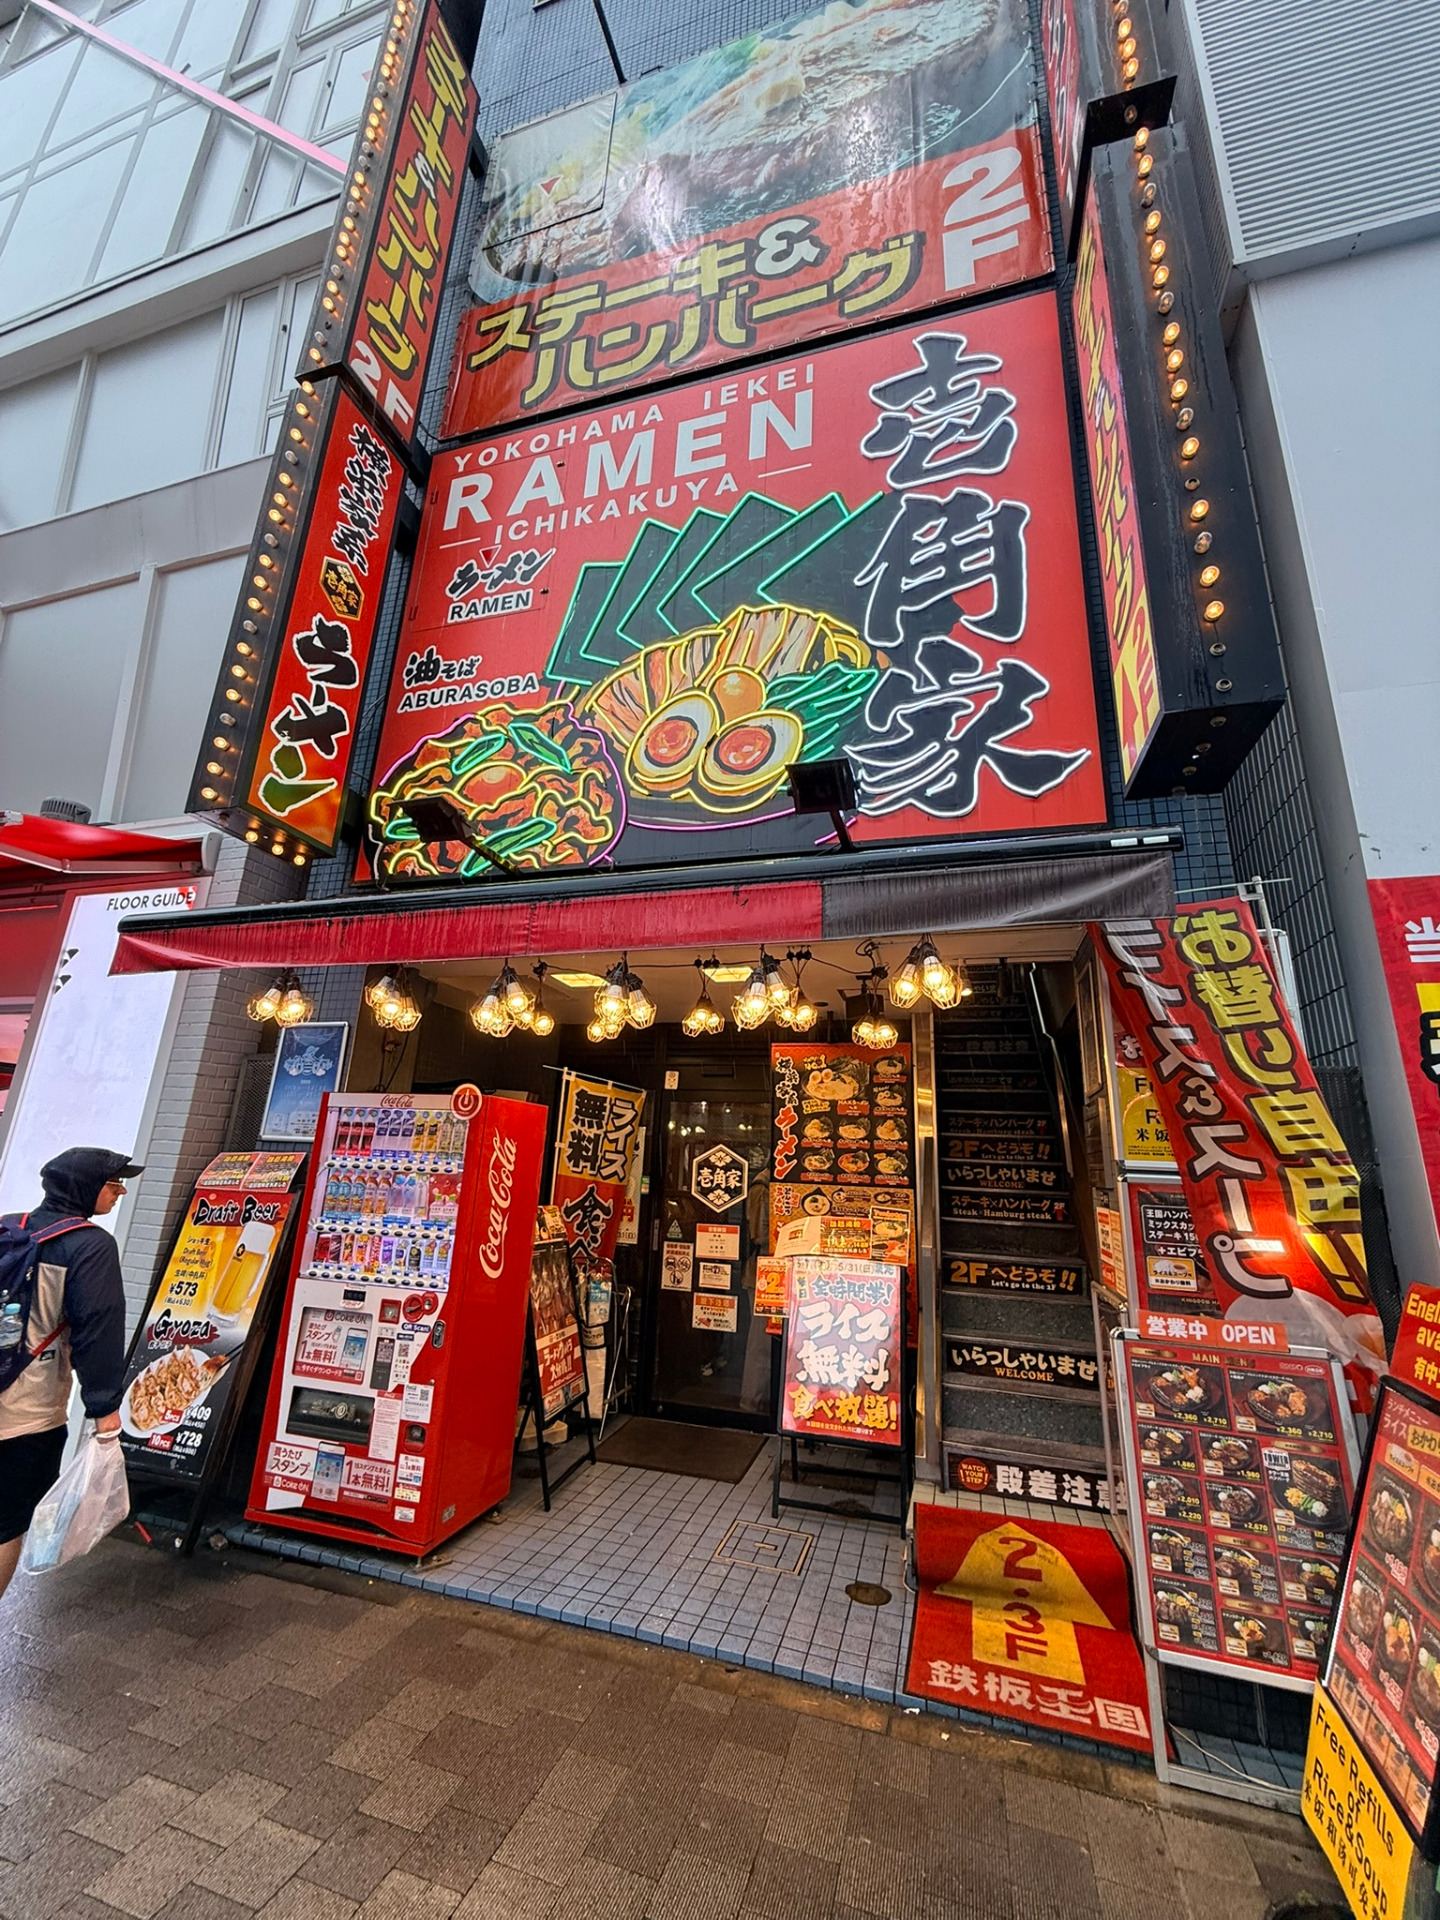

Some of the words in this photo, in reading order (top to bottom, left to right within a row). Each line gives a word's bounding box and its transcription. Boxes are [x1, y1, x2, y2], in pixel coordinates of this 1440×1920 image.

[943, 146, 1031, 292] 2F
[523, 234, 922, 407] ハンバーグ
[454, 404, 664, 472] YOKOHAMA
[703, 363, 815, 409] IEKEI
[440, 389, 814, 532] RAMEN
[493, 472, 739, 546] ICHIKAKUYA
[445, 547, 557, 599] ラーメン
[448, 589, 532, 624] RAMEN
[403, 644, 481, 685] 油そば
[398, 672, 539, 713] ABURASOBA
[257, 612, 359, 818] ラーメン
[106, 894, 150, 911] FLOOR
[152, 890, 194, 908] GUIDE
[565, 1088, 608, 1176] 無料
[599, 1099, 638, 1182] ライス
[774, 1105, 799, 1181] ラーメン
[697, 1167, 743, 1189] 壱角家
[948, 1166, 1056, 1185] いらっしゃいませ
[980, 1180, 1024, 1189] WELCOME
[193, 1197, 240, 1226] Draft
[241, 1195, 280, 1226] Beer
[1027, 1211, 1052, 1220] steak
[1148, 1230, 1182, 1240] ステーキ
[169, 1281, 198, 1297] ¥573
[991, 1280, 1009, 1288] Let's
[1011, 1281, 1020, 1290] go
[1022, 1281, 1030, 1289] to
[1032, 1281, 1046, 1289] the
[153, 1308, 212, 1341] Gyoza
[799, 1301, 890, 1342] ライス
[1146, 1315, 1208, 1341] 営業中
[1221, 1324, 1276, 1345] OPEN
[796, 1339, 891, 1391] 無料
[953, 1346, 1098, 1381] いらっしゃいませ
[995, 1367, 1055, 1382] WELCOME
[1192, 1353, 1220, 1364] MAIN
[788, 1384, 898, 1431] 食べ放題!
[175, 1431, 203, 1447] ¥728
[1383, 1413, 1408, 1440] ライス
[270, 1457, 310, 1477] スタンプ
[962, 1463, 987, 1473] WATCH
[965, 1471, 984, 1479] YOUR
[967, 1477, 983, 1485] STEP
[926, 1658, 1151, 1739] 鉄板王国
[1314, 1702, 1346, 1767] Free
[1349, 1758, 1394, 1857] Refills
[1347, 1791, 1362, 1824] of
